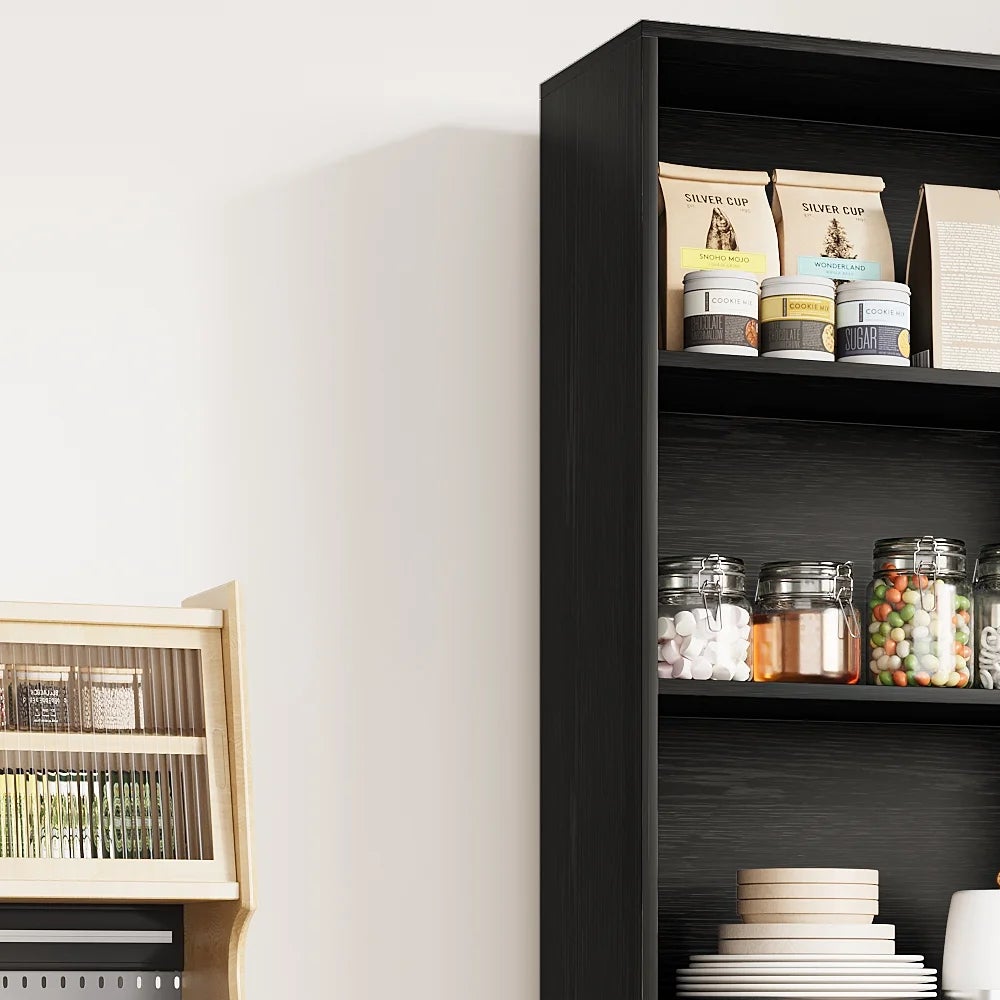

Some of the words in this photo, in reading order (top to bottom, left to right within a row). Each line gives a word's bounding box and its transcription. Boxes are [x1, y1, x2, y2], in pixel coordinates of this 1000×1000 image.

[685, 193, 723, 205] SILVER
[726, 196, 749, 207] CUP
[802, 202, 840, 214] SILVER
[842, 206, 865, 216] CUP
[728, 256, 750, 264] MOJO
[814, 261, 866, 272] WONDERLAND
[711, 297, 741, 305] COOKIE
[789, 302, 818, 310] COOKIE
[865, 308, 895, 316] COOKIE
[845, 326, 877, 351] SUGAR
